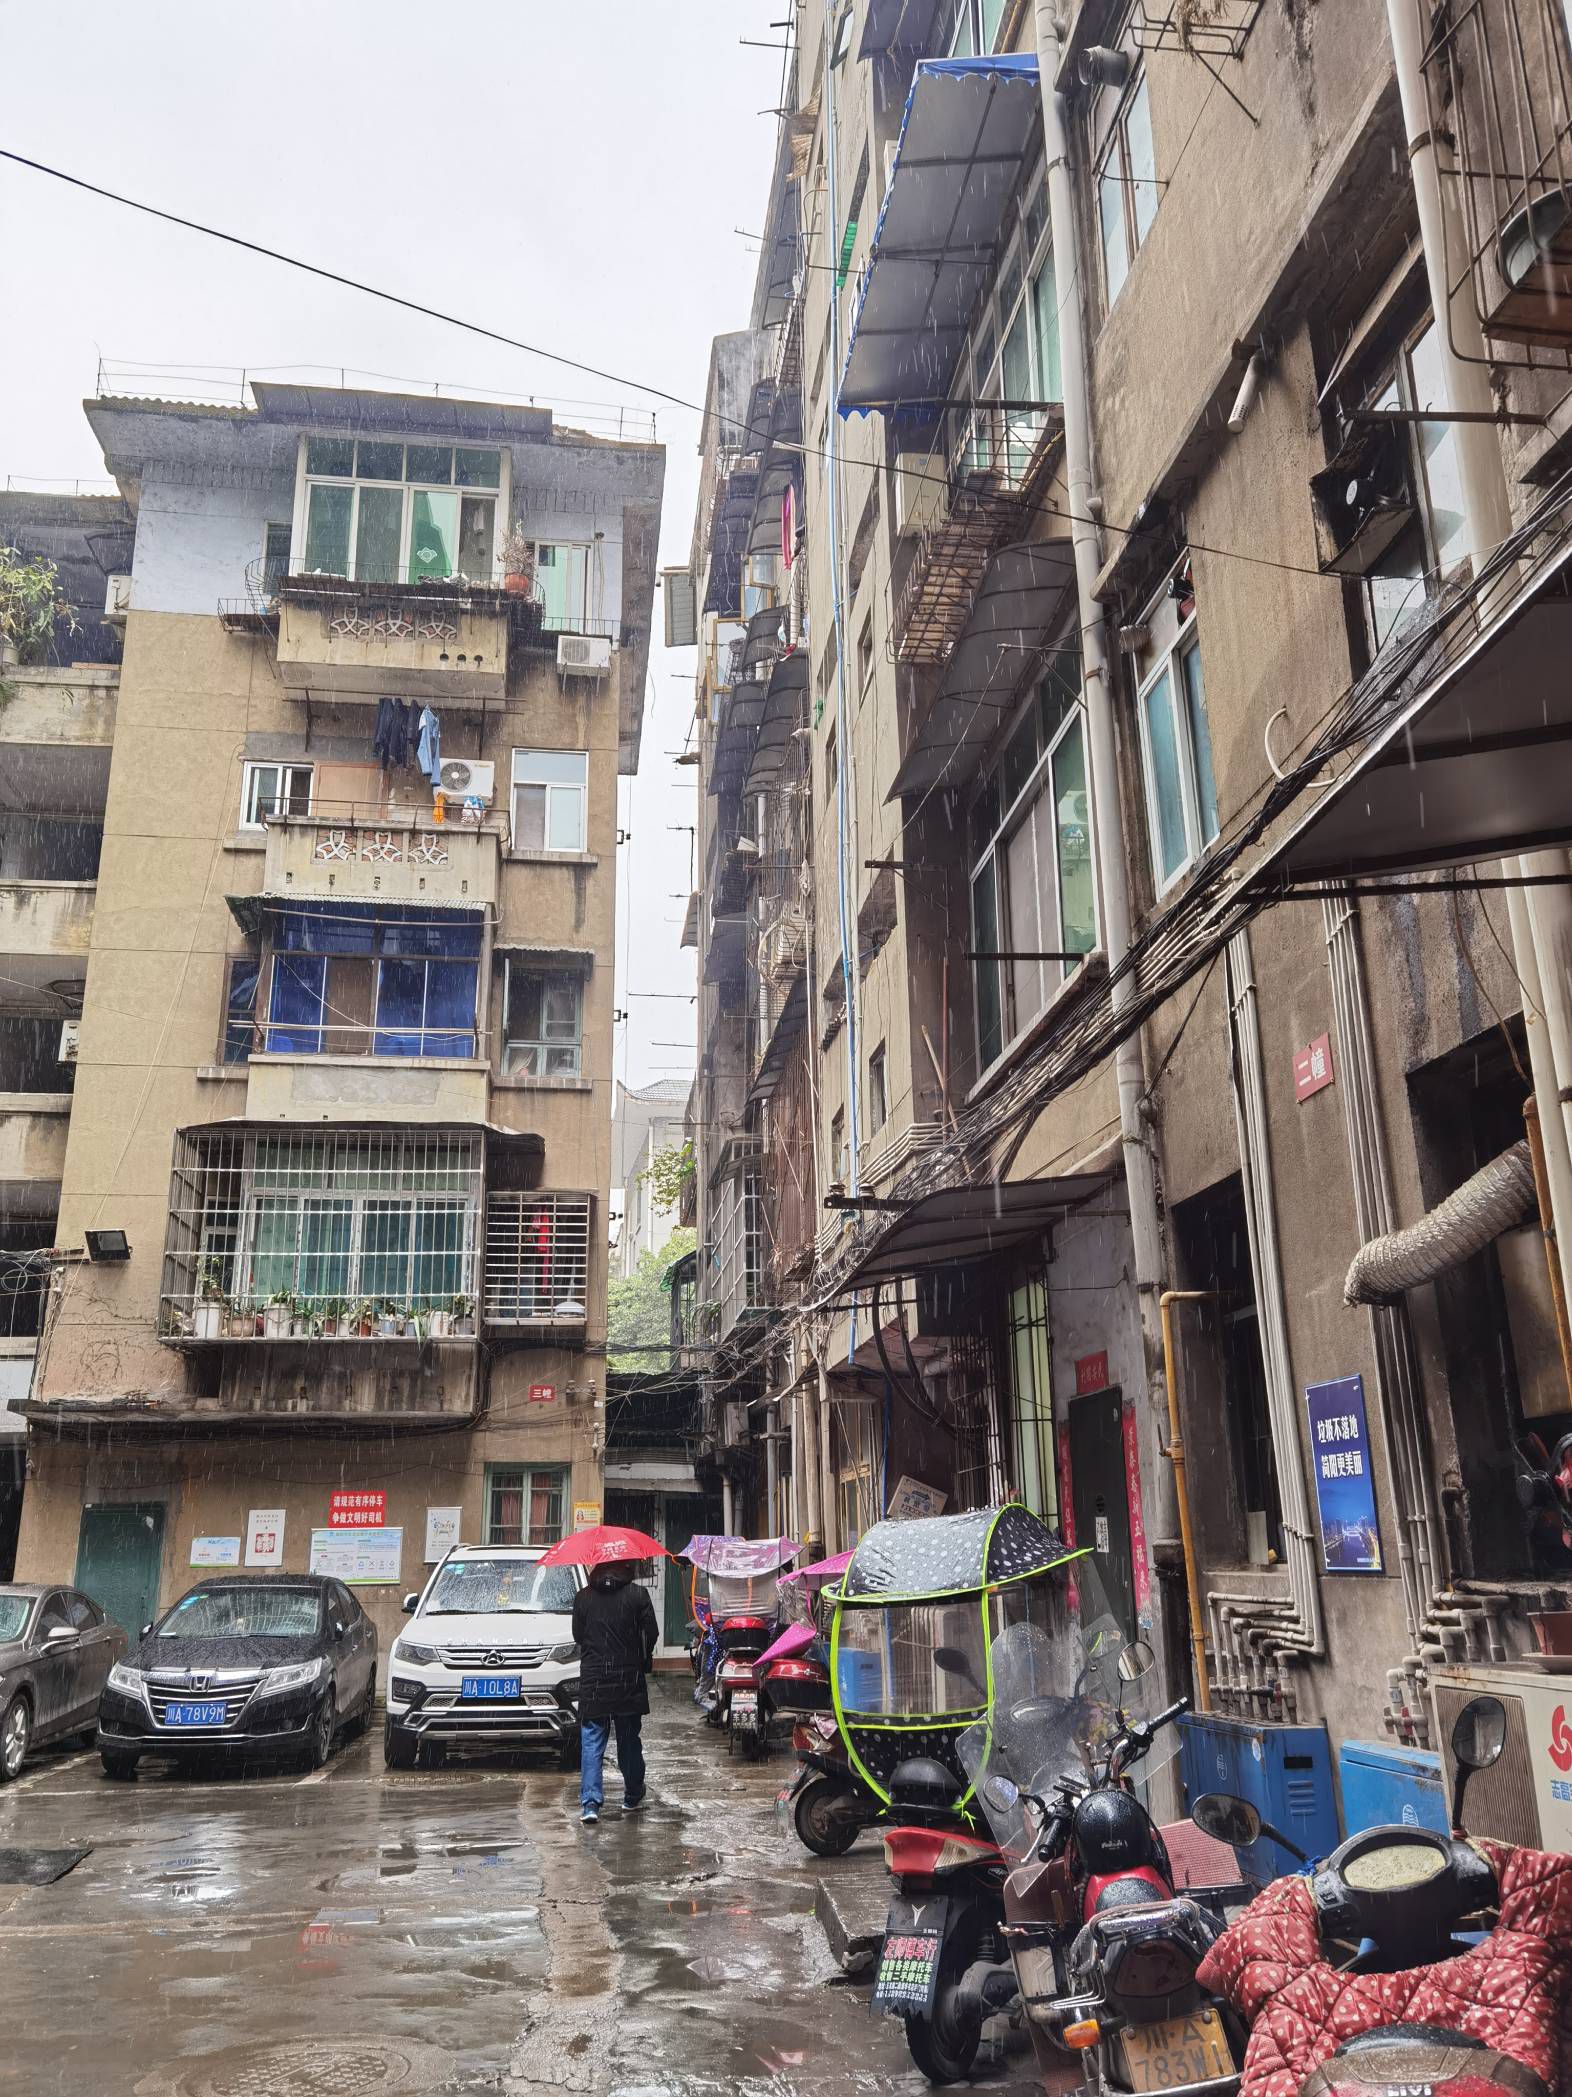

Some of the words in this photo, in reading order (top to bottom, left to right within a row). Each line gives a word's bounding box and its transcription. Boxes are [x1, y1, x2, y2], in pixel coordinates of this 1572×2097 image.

[1317, 1413, 1359, 1443] 垃圾不落地
[1321, 1450, 1363, 1479] 简阳更美丽
[333, 1495, 384, 1508] 请规范有序停车
[332, 1511, 383, 1524] 争做文明好司机
[1551, 1779, 1572, 1801] 志高
